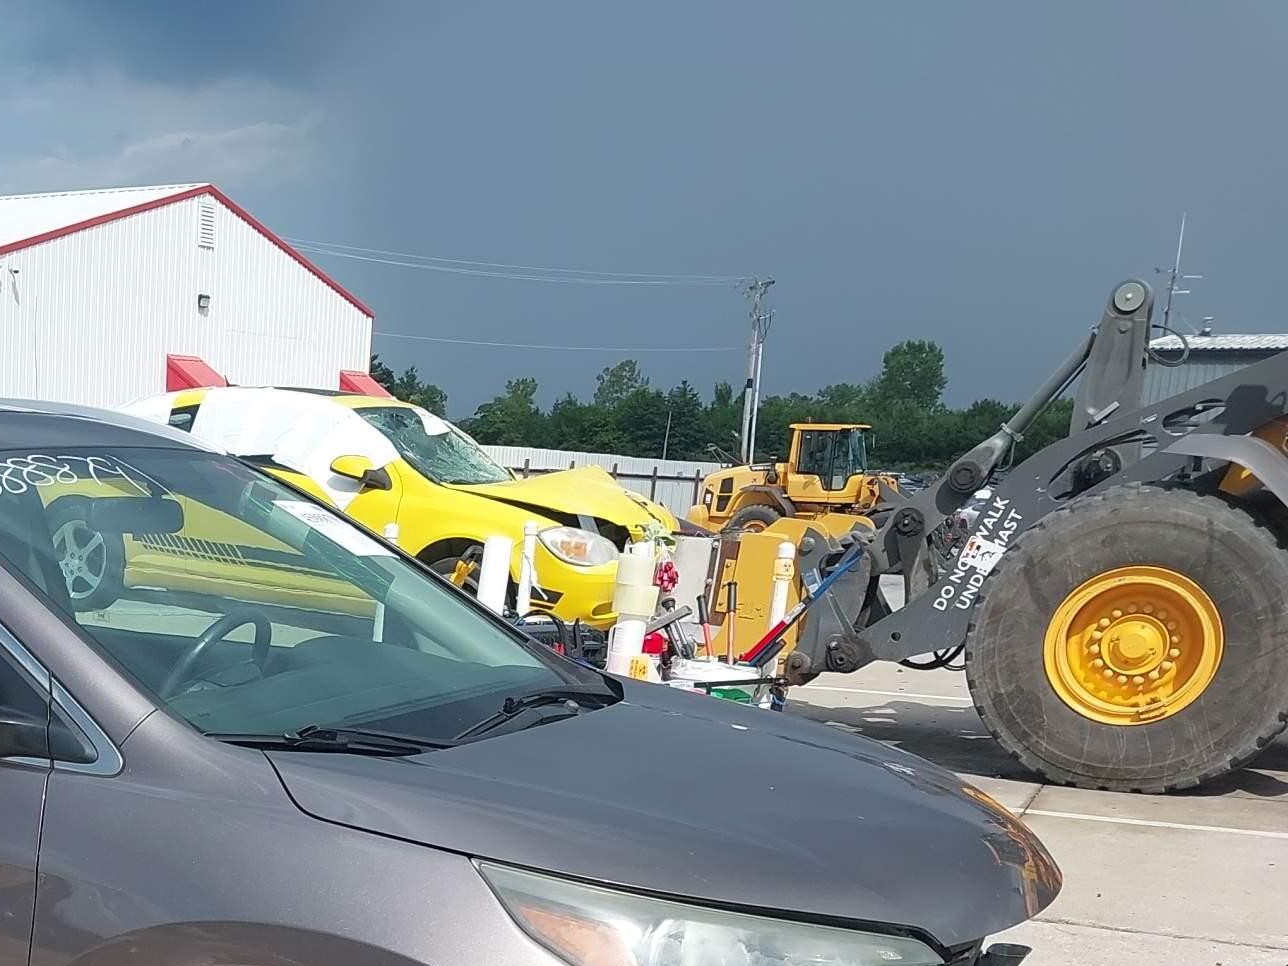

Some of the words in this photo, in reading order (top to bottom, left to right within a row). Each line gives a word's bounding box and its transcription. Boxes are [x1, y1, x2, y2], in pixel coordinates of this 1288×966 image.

[933, 585, 955, 611] DO
[975, 496, 1010, 540] WALK
[956, 566, 989, 610] UNDE
